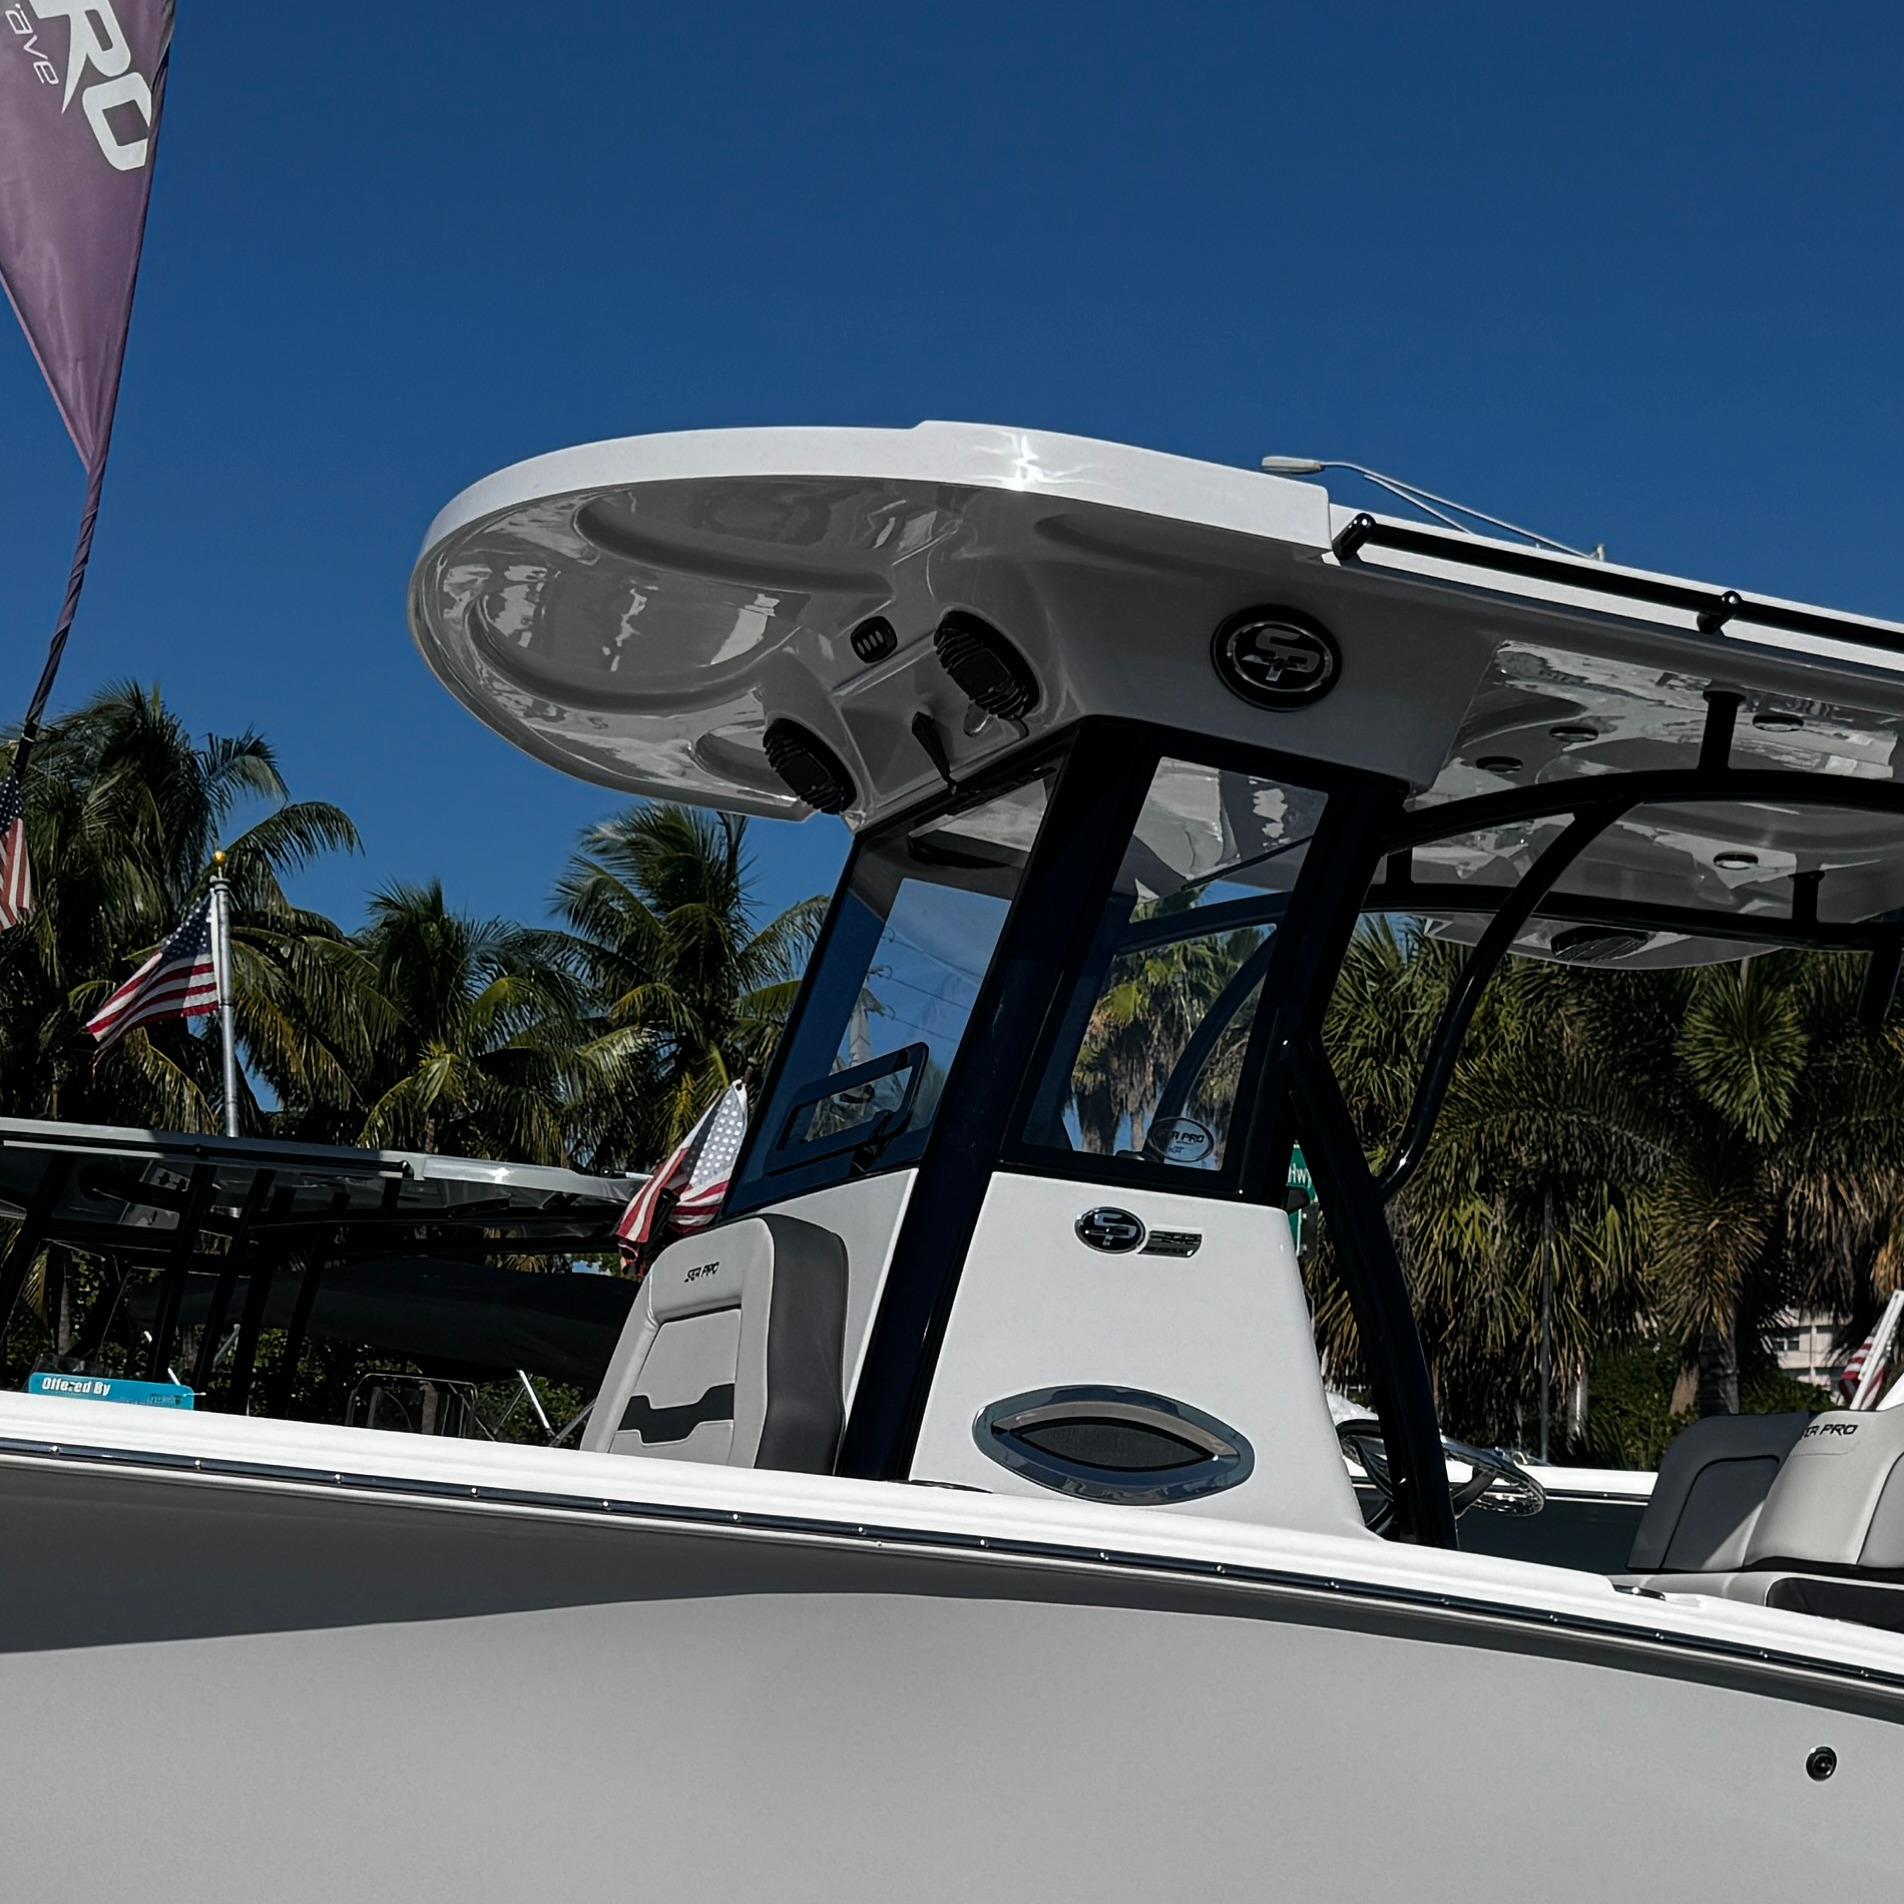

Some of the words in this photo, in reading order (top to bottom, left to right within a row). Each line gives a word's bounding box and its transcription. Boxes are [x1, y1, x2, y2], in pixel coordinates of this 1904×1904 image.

[5, 3, 59, 84] ave
[29, 0, 152, 171] RO
[41, 1376, 91, 1394] Offered
[93, 1381, 111, 1397] By
[1819, 1424, 1859, 1436] PRO
